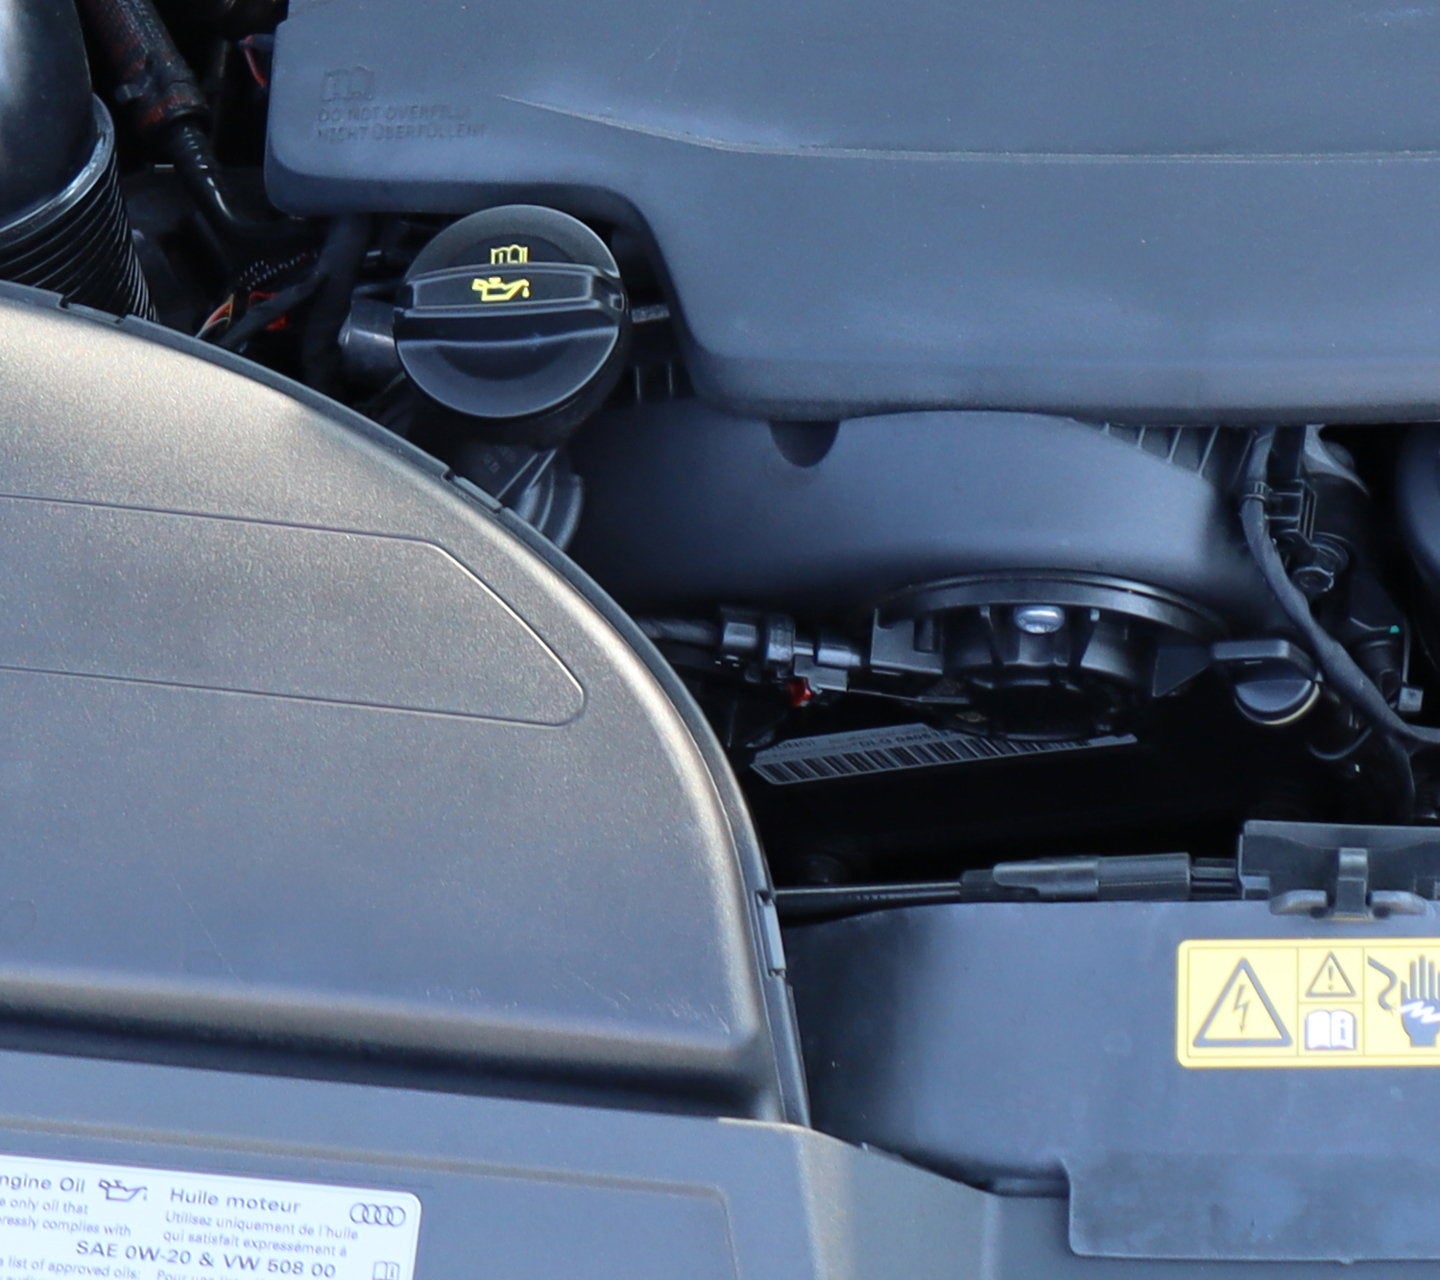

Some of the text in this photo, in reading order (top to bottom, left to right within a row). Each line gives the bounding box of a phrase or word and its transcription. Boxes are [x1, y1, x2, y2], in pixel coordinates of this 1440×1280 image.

[59, 1176, 86, 1193] Oil
[10, 1196, 37, 1212] only
[42, 1199, 59, 1213] oil
[63, 1201, 89, 1215] that
[169, 1187, 302, 1214] Huile moteur
[42, 1219, 100, 1235] complies
[104, 1223, 131, 1237] with
[165, 1210, 212, 1227] Utilisez
[216, 1218, 295, 1237] uniquement
[298, 1225, 315, 1237] de
[162, 1230, 185, 1244] qui
[188, 1233, 239, 1248] satisfait
[8, 1256, 27, 1271] list
[29, 1258, 44, 1272] of
[47, 1262, 110, 1278] approved
[76, 1240, 337, 1279] SAE 0W-20 & VW 508 00
